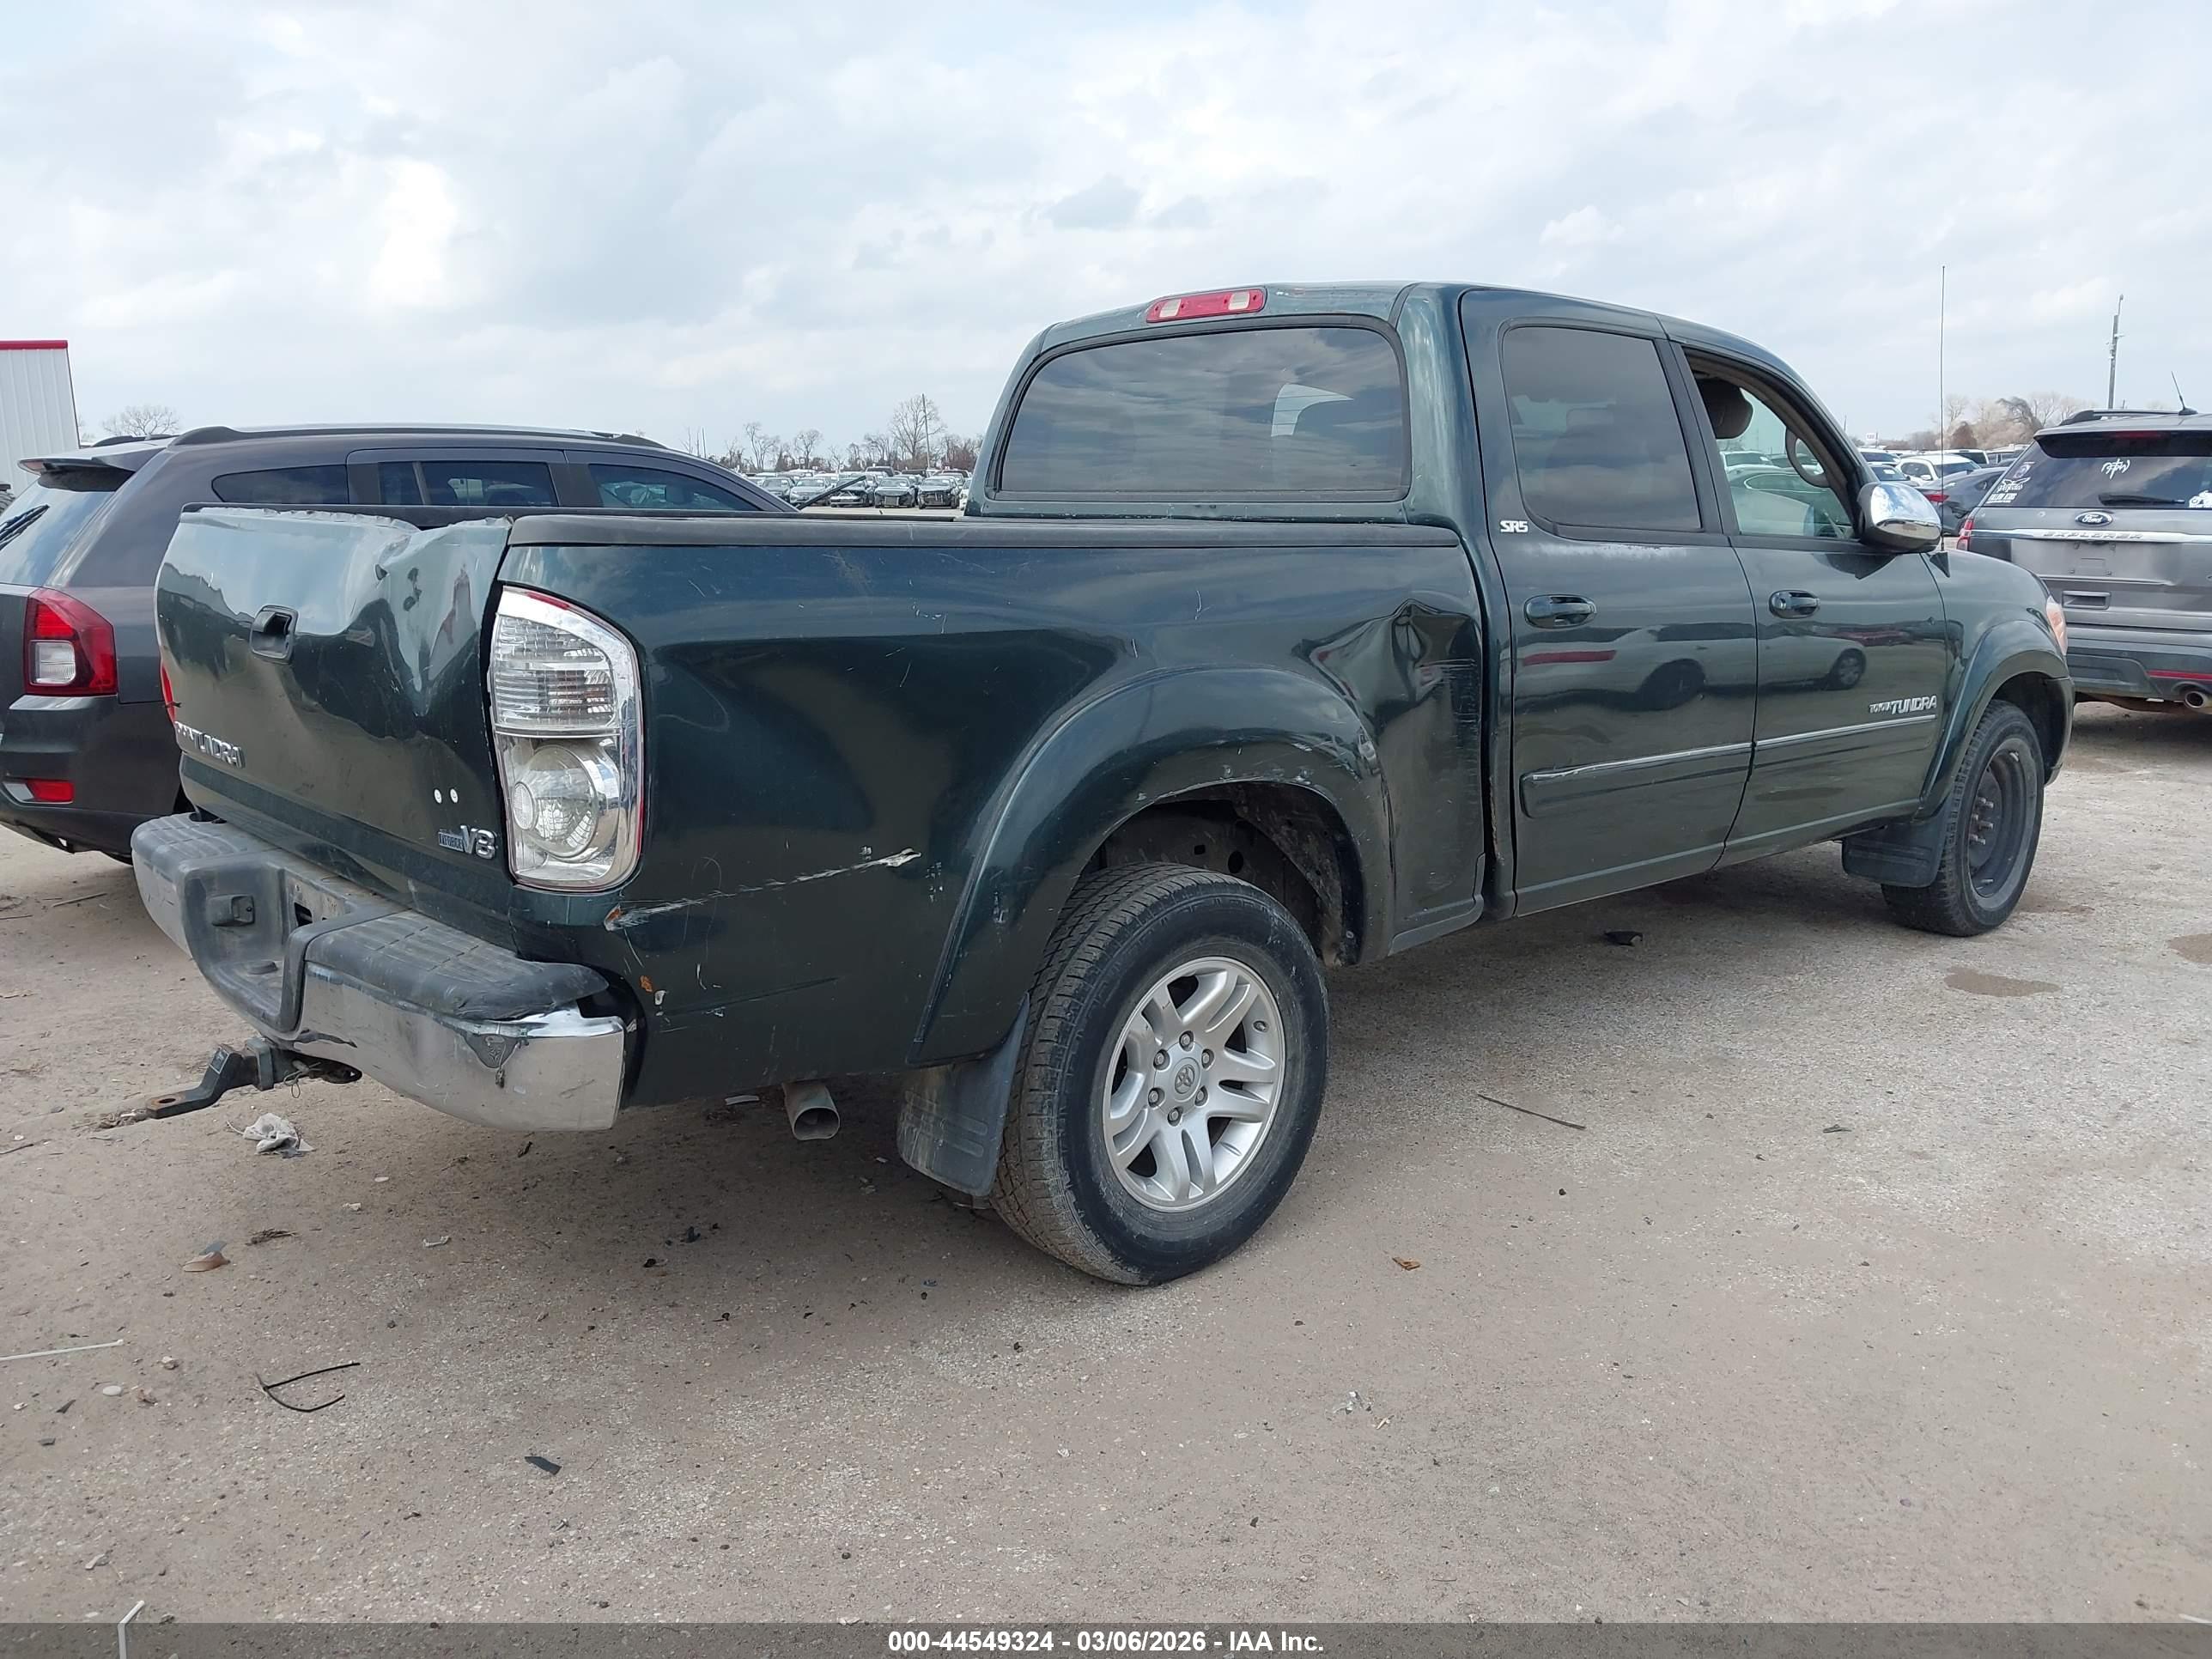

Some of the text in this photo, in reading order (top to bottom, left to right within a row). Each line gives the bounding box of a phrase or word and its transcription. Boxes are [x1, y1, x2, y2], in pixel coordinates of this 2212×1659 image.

[1499, 520, 1528, 533] SR5
[2081, 514, 2103, 524] Ford
[2043, 531, 2143, 539] EXPLORER
[1891, 695, 1937, 714] TUNDRA
[191, 728, 245, 769] TUNDRA
[460, 824, 495, 860] V8
